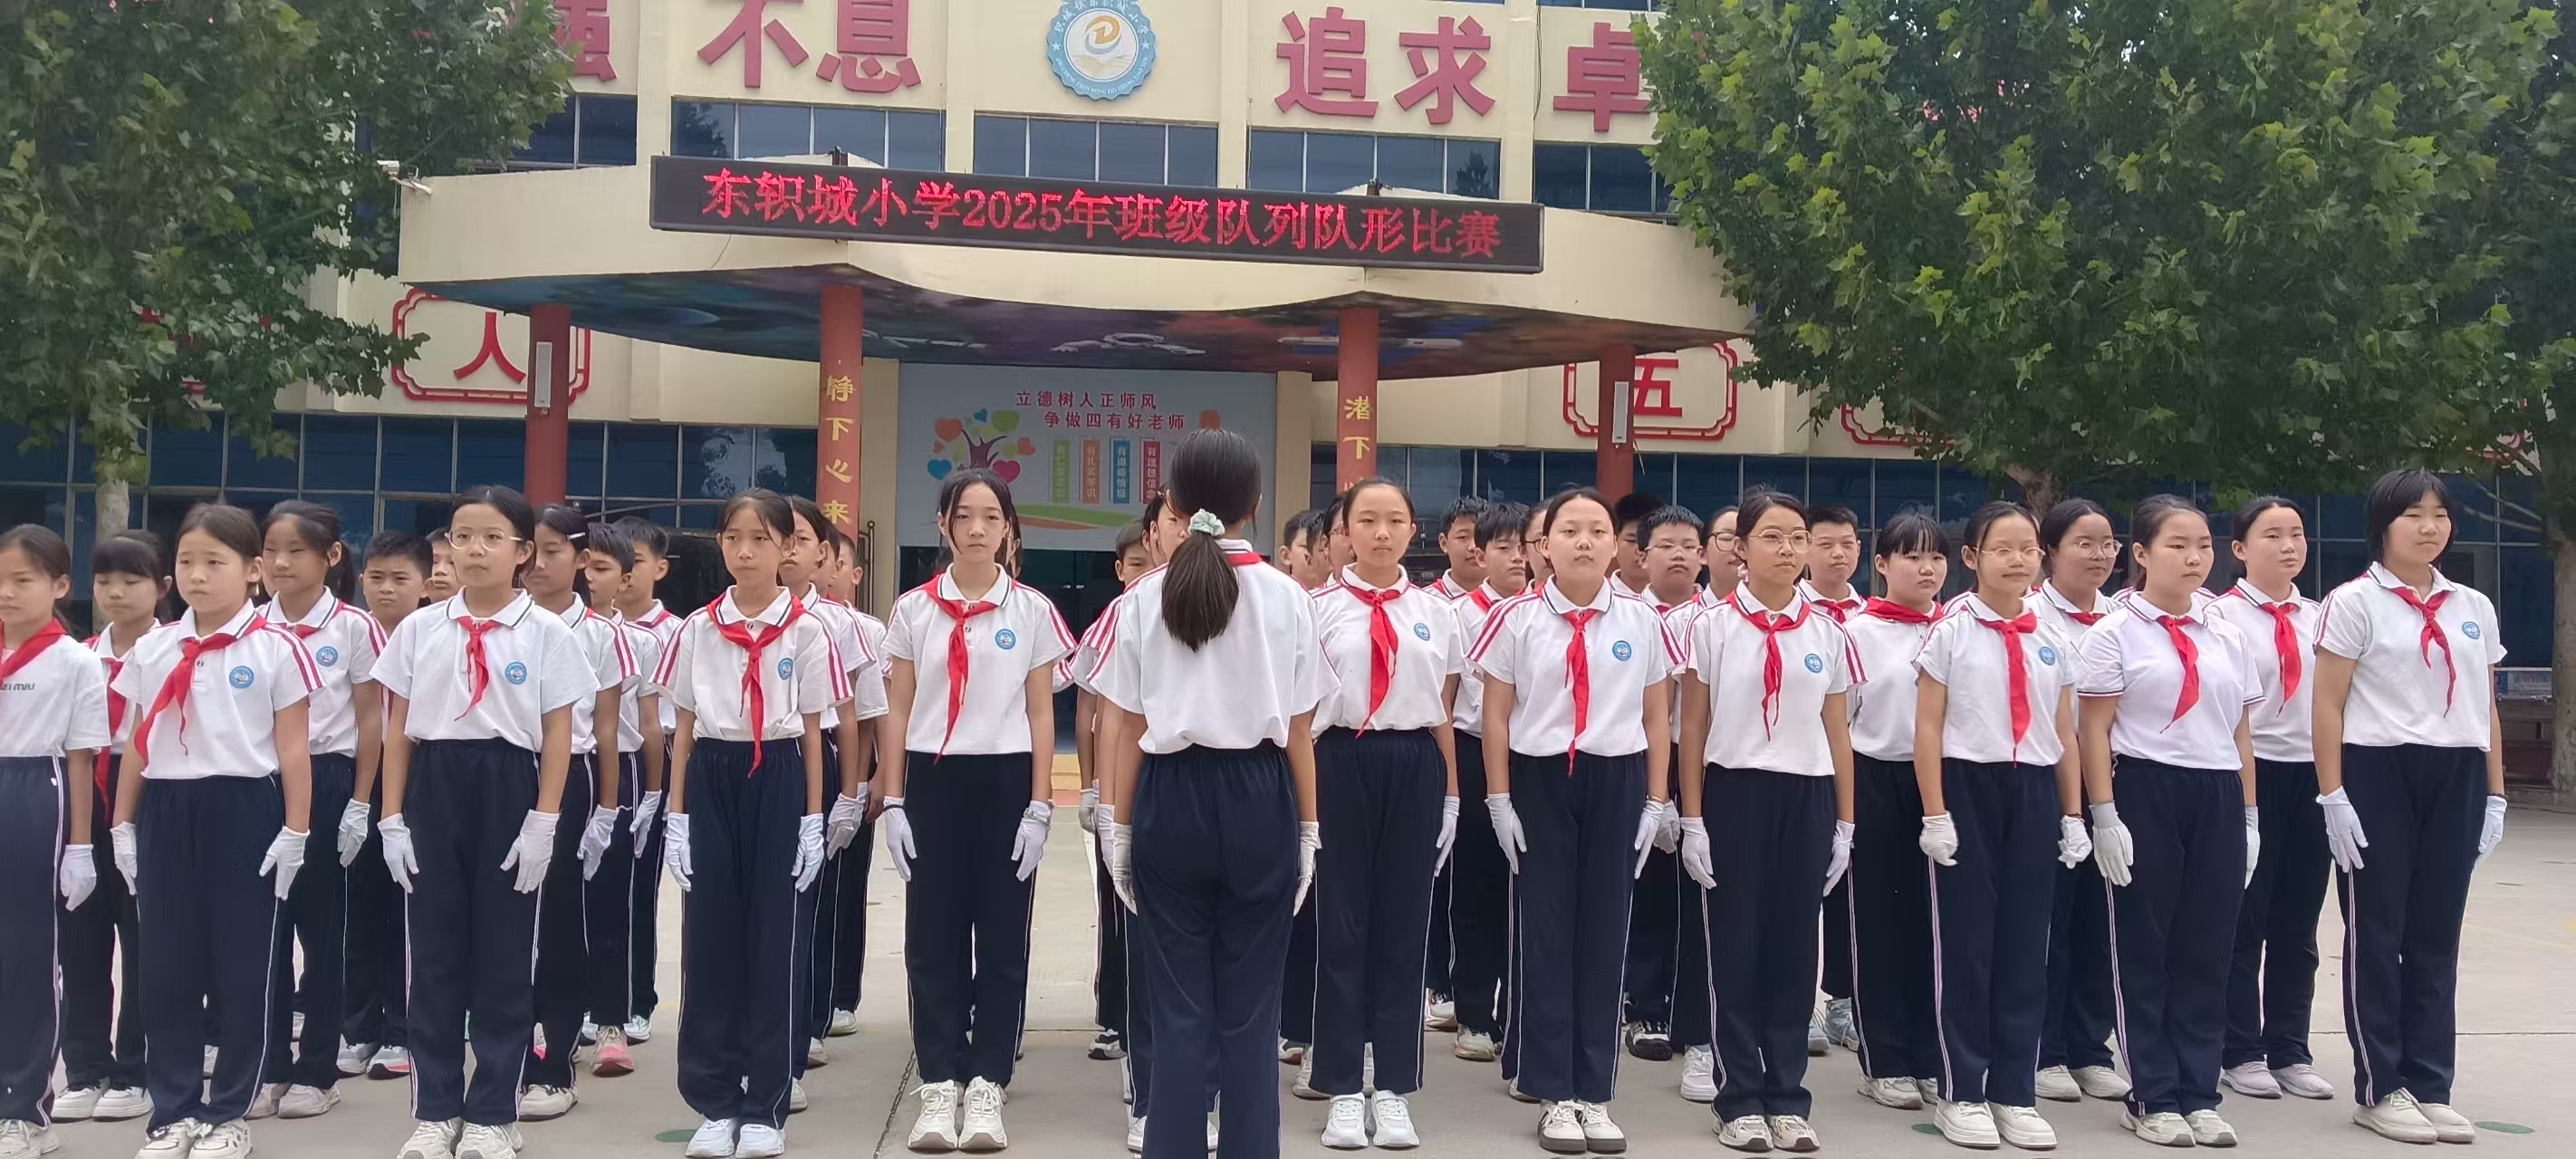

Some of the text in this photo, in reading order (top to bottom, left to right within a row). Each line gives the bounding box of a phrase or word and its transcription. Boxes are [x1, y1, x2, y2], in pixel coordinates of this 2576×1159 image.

[702, 167, 1500, 259] 东轵城小学2025年班级队列队形比赛
[1015, 390, 1157, 410] 立德树人正师风
[1043, 410, 1186, 431] 争做四有好老师
